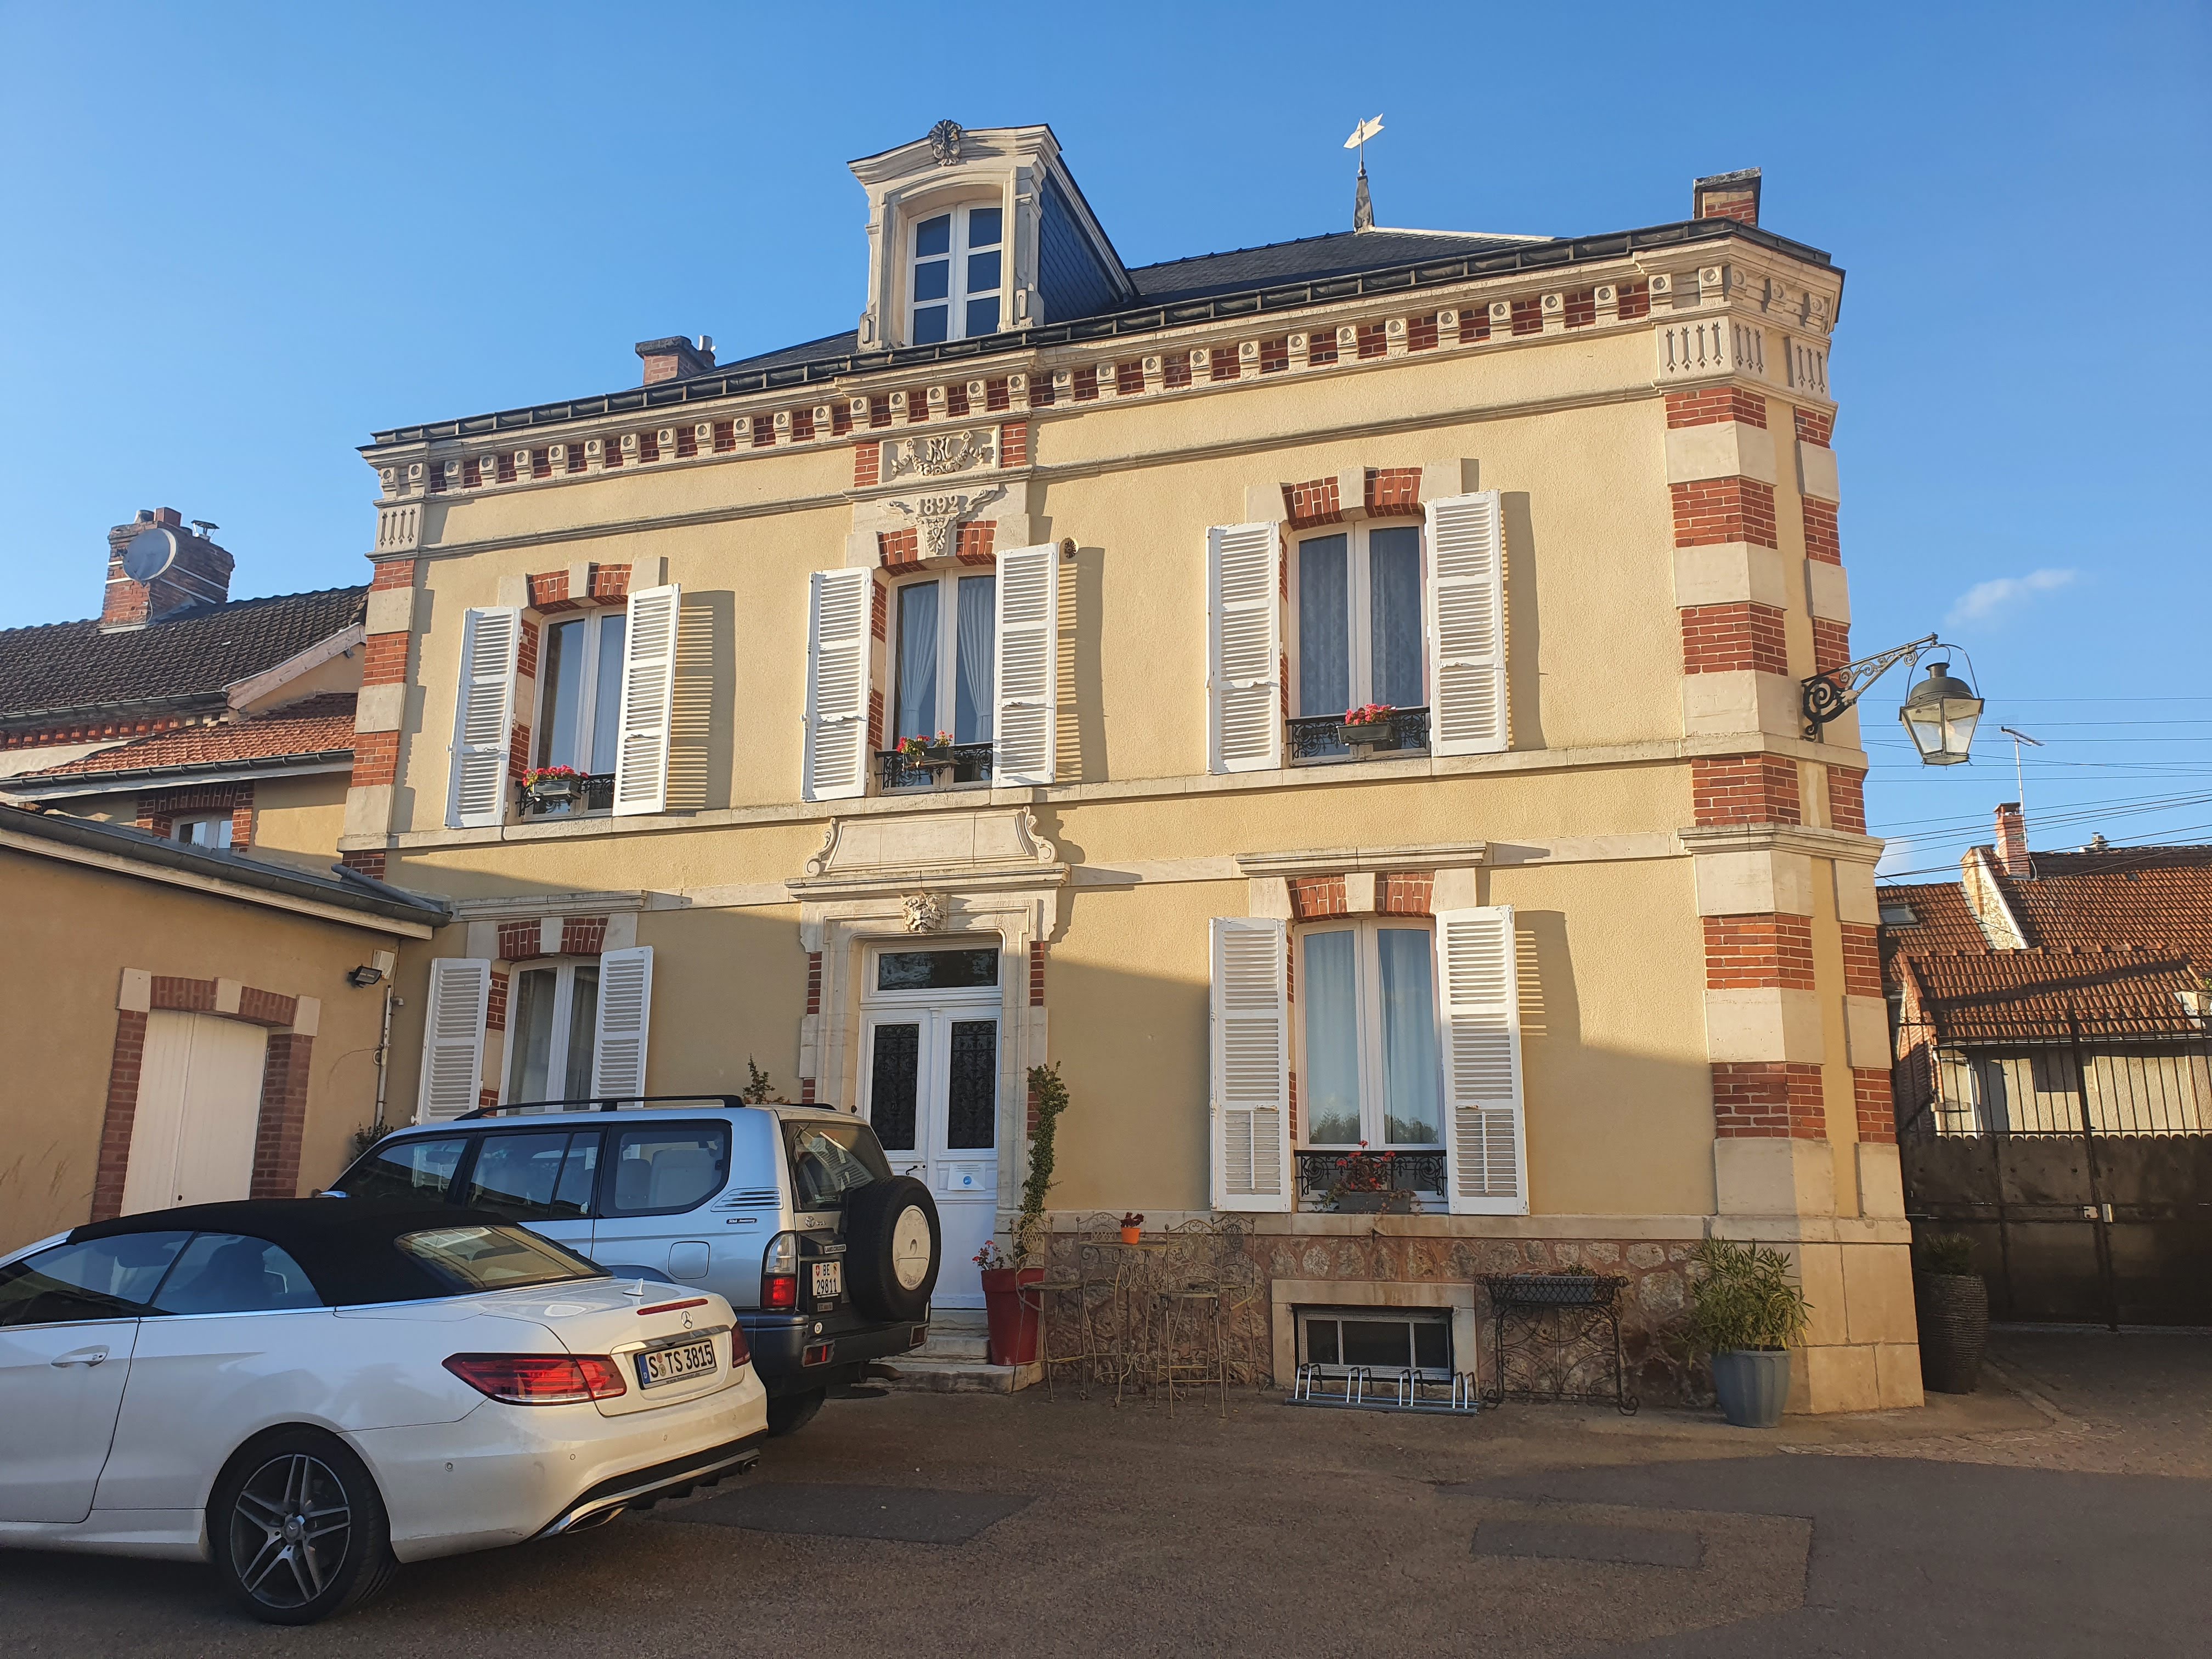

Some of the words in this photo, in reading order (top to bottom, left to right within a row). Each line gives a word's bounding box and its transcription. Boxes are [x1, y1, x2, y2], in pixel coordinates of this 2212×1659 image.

[916, 495, 958, 516] 1892
[823, 1264, 830, 1276] BE
[816, 1278, 837, 1294] 29811
[648, 1356, 658, 1378] S
[664, 1351, 683, 1374] TS
[684, 1344, 713, 1369] 3815
